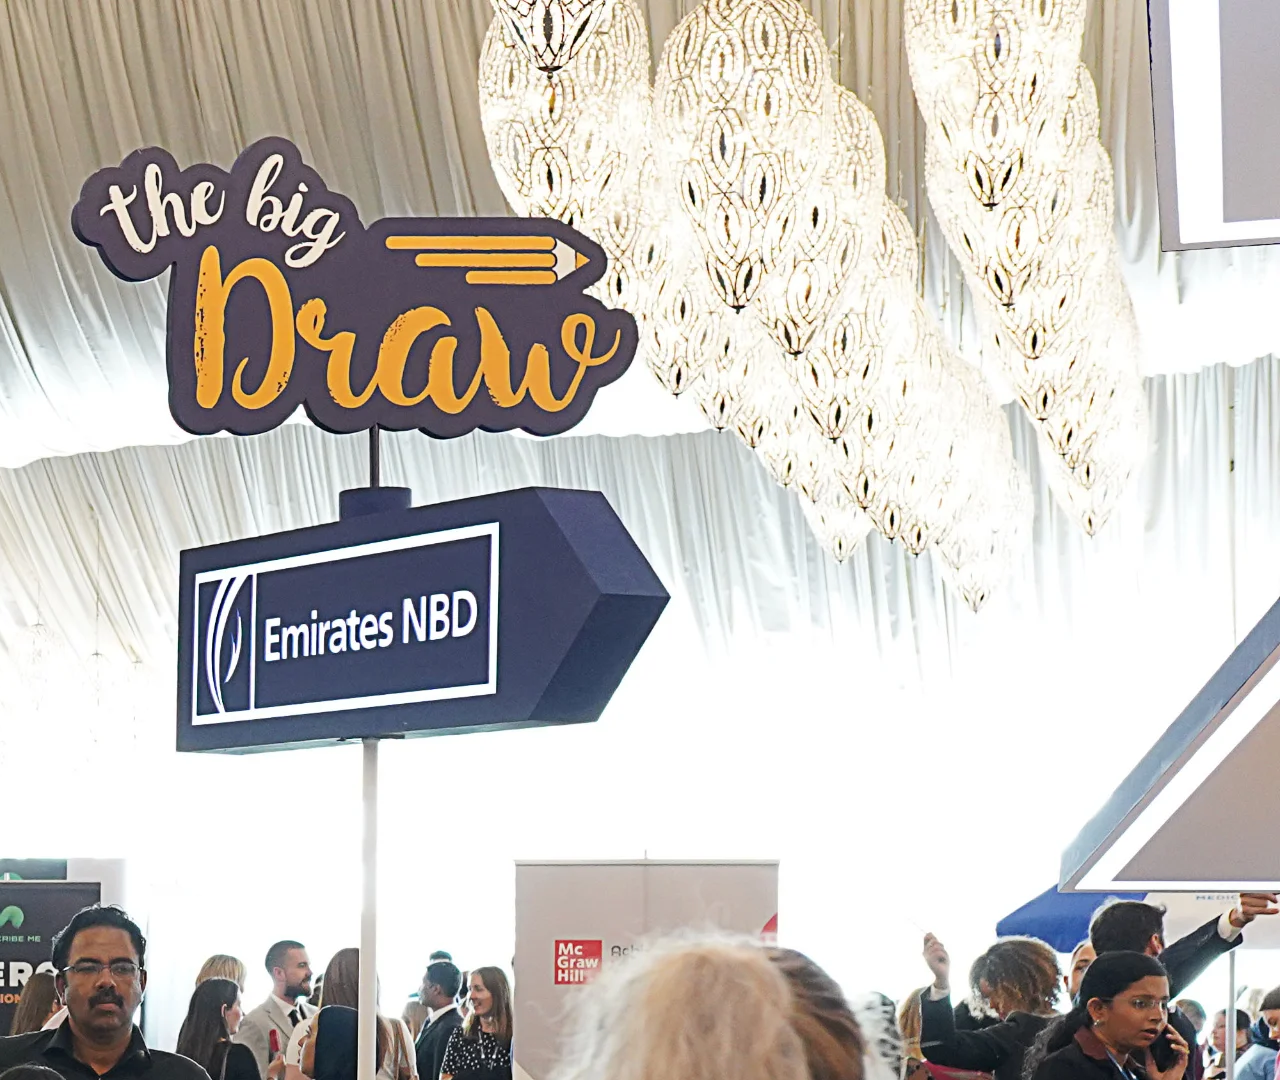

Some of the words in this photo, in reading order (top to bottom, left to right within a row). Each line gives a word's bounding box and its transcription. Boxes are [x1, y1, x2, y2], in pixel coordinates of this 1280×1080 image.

[100, 163, 226, 253] the
[245, 154, 346, 268] big
[194, 245, 621, 414] Draw
[264, 609, 394, 662] Emirates
[402, 590, 479, 644] NBD
[27, 935, 41, 943] ME
[558, 942, 583, 956] Mc
[557, 956, 599, 969] Graw
[557, 969, 584, 983] Hill
